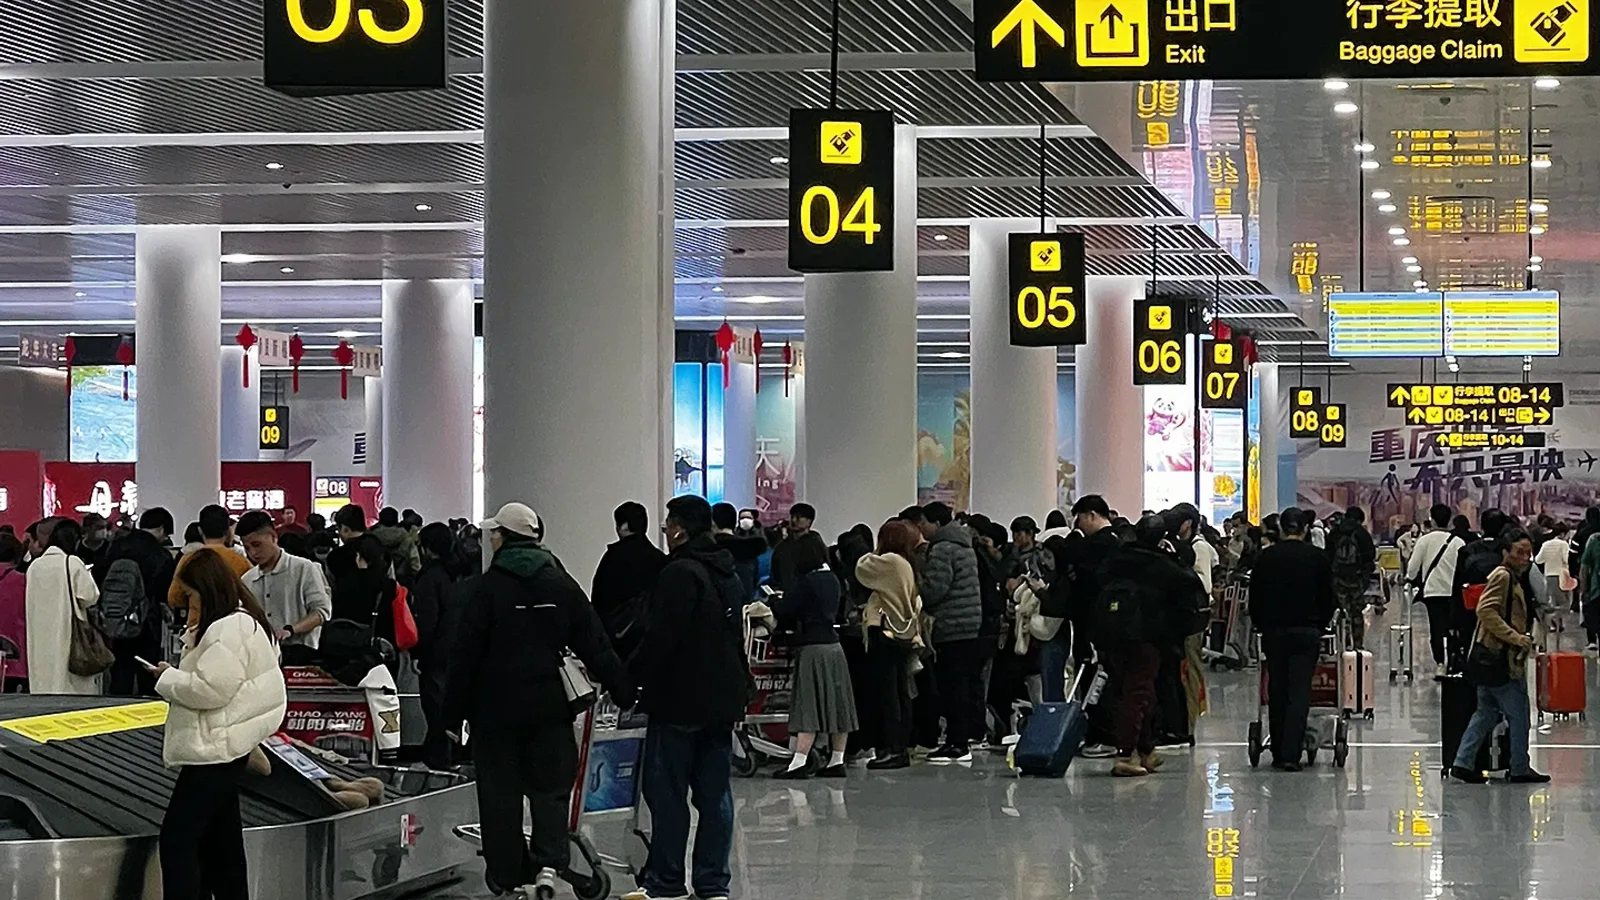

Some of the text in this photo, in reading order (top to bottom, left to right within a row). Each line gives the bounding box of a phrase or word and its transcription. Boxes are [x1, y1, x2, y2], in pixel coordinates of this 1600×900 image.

[1166, 0, 1236, 32] 出口
[1347, 0, 1502, 29] 行李提取
[1166, 45, 1206, 63] Exit
[1339, 40, 1503, 64] Baggage Claim
[801, 186, 881, 244] 04
[1017, 287, 1076, 328] 05
[1138, 340, 1182, 373] 06
[1206, 371, 1240, 399] 07
[1498, 386, 1551, 404] 08-14
[1292, 410, 1319, 432] 08
[1444, 407, 1489, 423] 08-14
[261, 425, 281, 444] 09
[1321, 424, 1345, 443] 09
[1491, 433, 1525, 447] 10-14
[1404, 447, 1565, 494] 不只是快
[329, 481, 348, 495] 08
[334, 711, 366, 719] YANG
